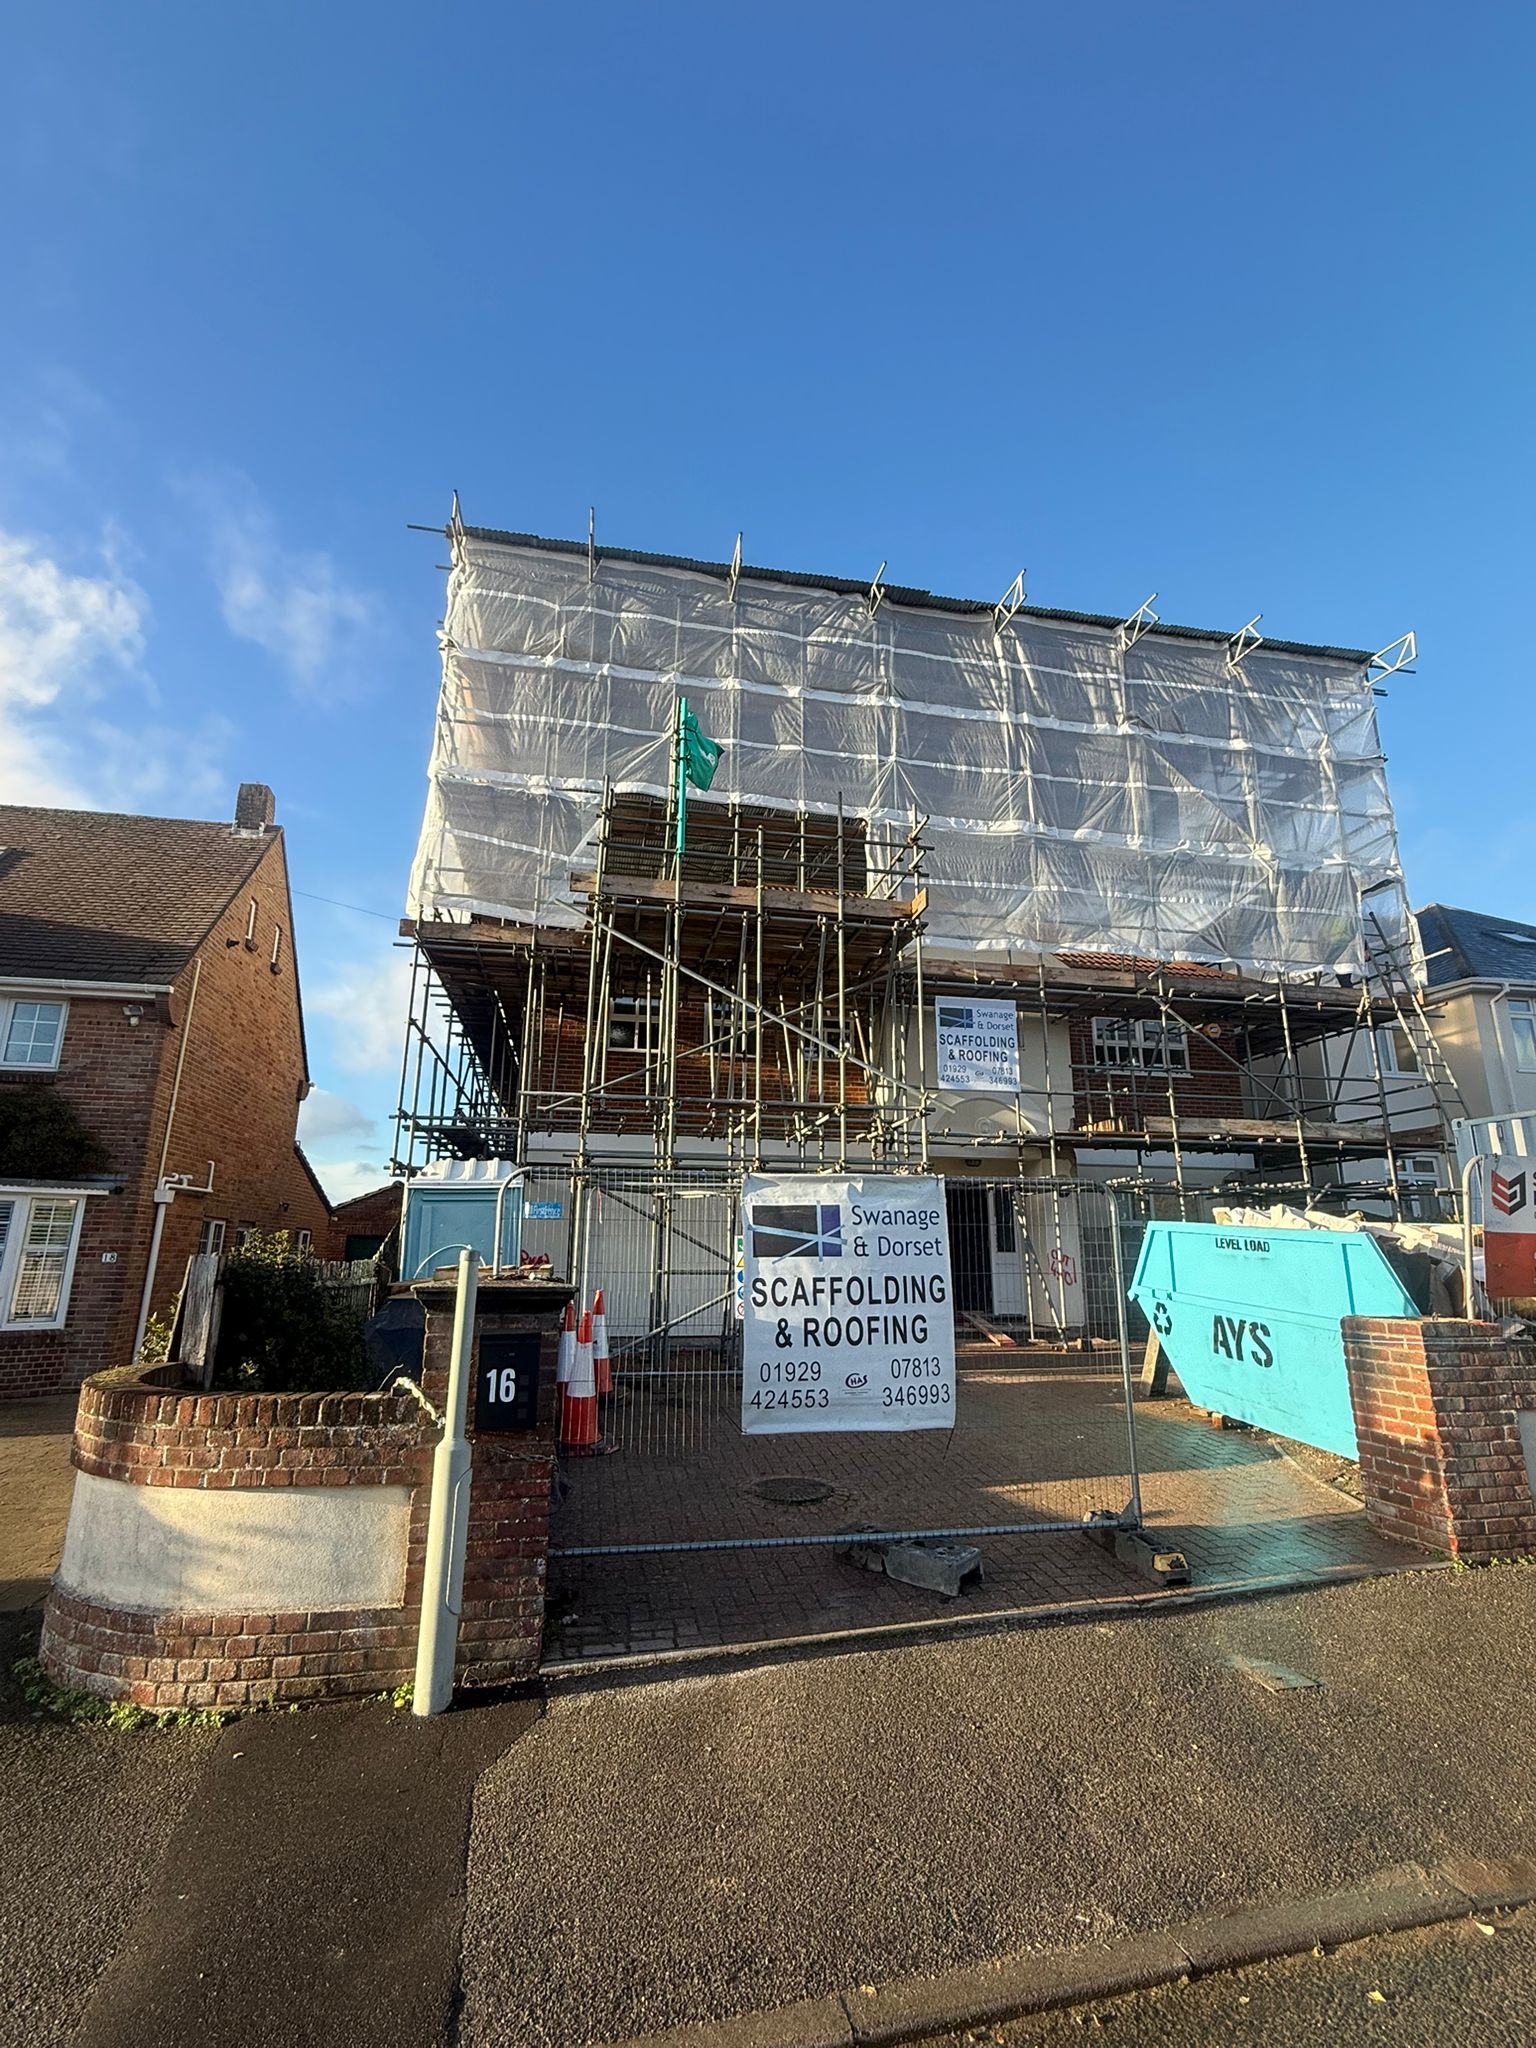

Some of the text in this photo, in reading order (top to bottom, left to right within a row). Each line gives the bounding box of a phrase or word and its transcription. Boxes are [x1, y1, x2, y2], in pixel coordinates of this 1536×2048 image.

[976, 1009, 1015, 1021] Swanage
[977, 1021, 1015, 1031] & Dorset
[939, 1033, 1016, 1049] SCAFFOLDING
[948, 1048, 1008, 1062] & ROOFING
[940, 1074, 970, 1083] 424553
[943, 1064, 967, 1073] 01929
[991, 1066, 1014, 1076] 07813
[989, 1076, 1018, 1086] 346993
[851, 1205, 940, 1230] Swanage
[853, 1236, 943, 1257] & Dorset
[1215, 1237, 1271, 1253] LEVEL LOAD
[751, 1274, 947, 1308] SCAFFOLDING
[775, 1314, 928, 1349] & ROOFING
[1212, 1314, 1273, 1369] AYS
[760, 1361, 821, 1383] 01929
[890, 1356, 941, 1380] 07813
[486, 1368, 516, 1403] 16
[882, 1383, 950, 1408] 346993
[750, 1389, 830, 1410] 424553
